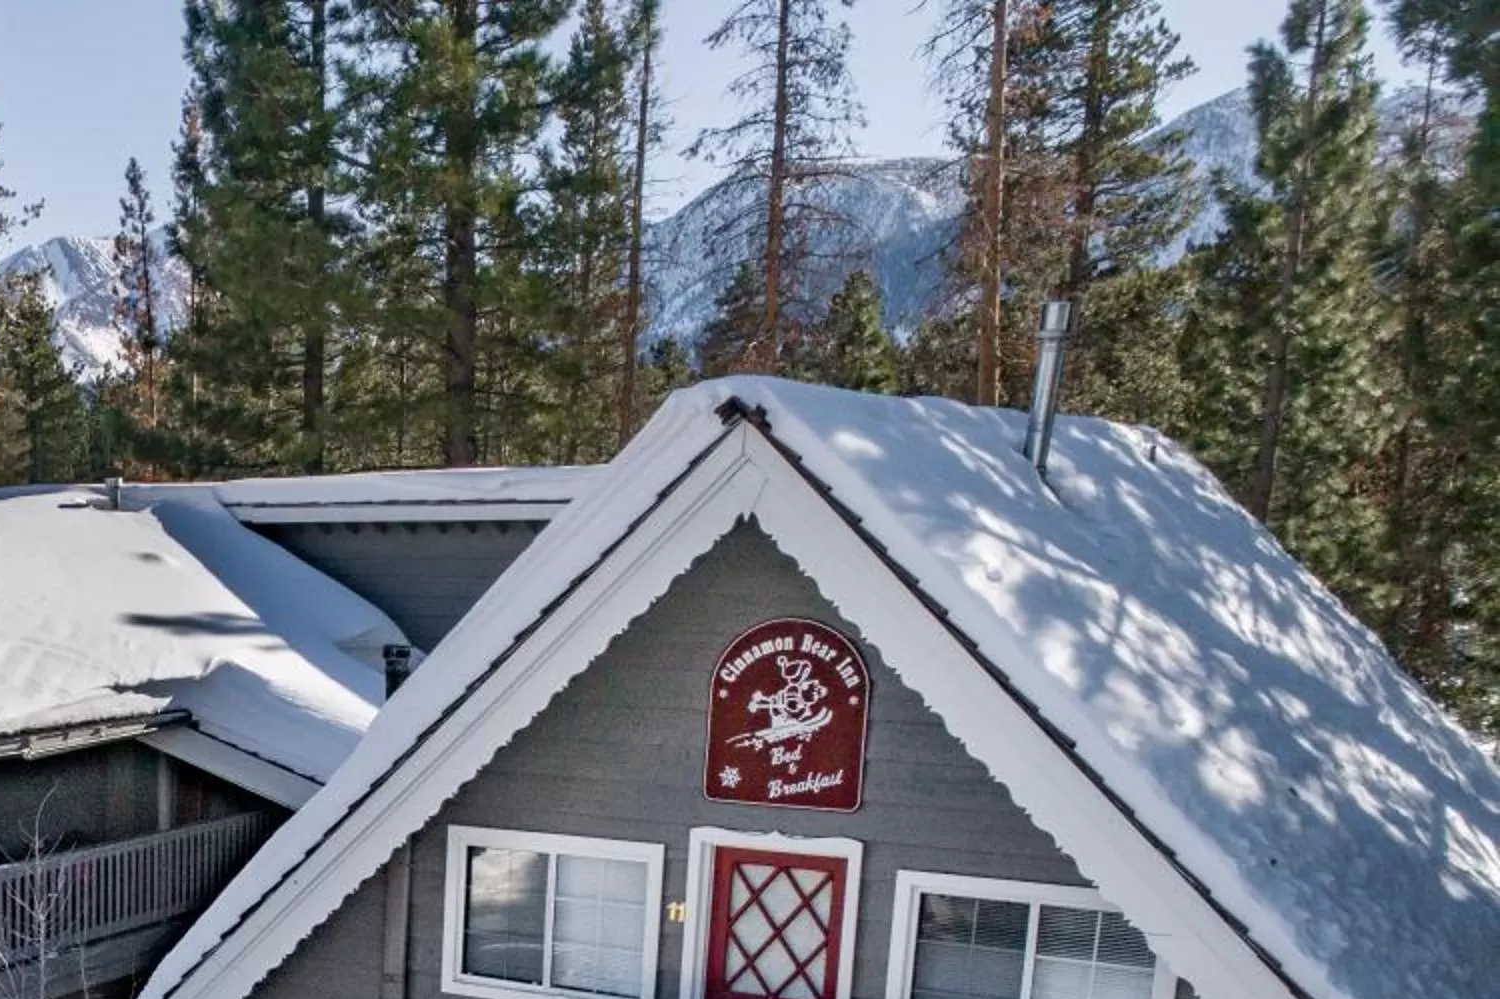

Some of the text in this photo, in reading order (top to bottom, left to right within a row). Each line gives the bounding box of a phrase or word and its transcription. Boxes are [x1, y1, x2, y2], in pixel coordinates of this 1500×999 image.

[720, 633, 861, 688] Cinnamon Bear Inn
[770, 744, 803, 765] Bed
[768, 769, 844, 799] Breakfast
